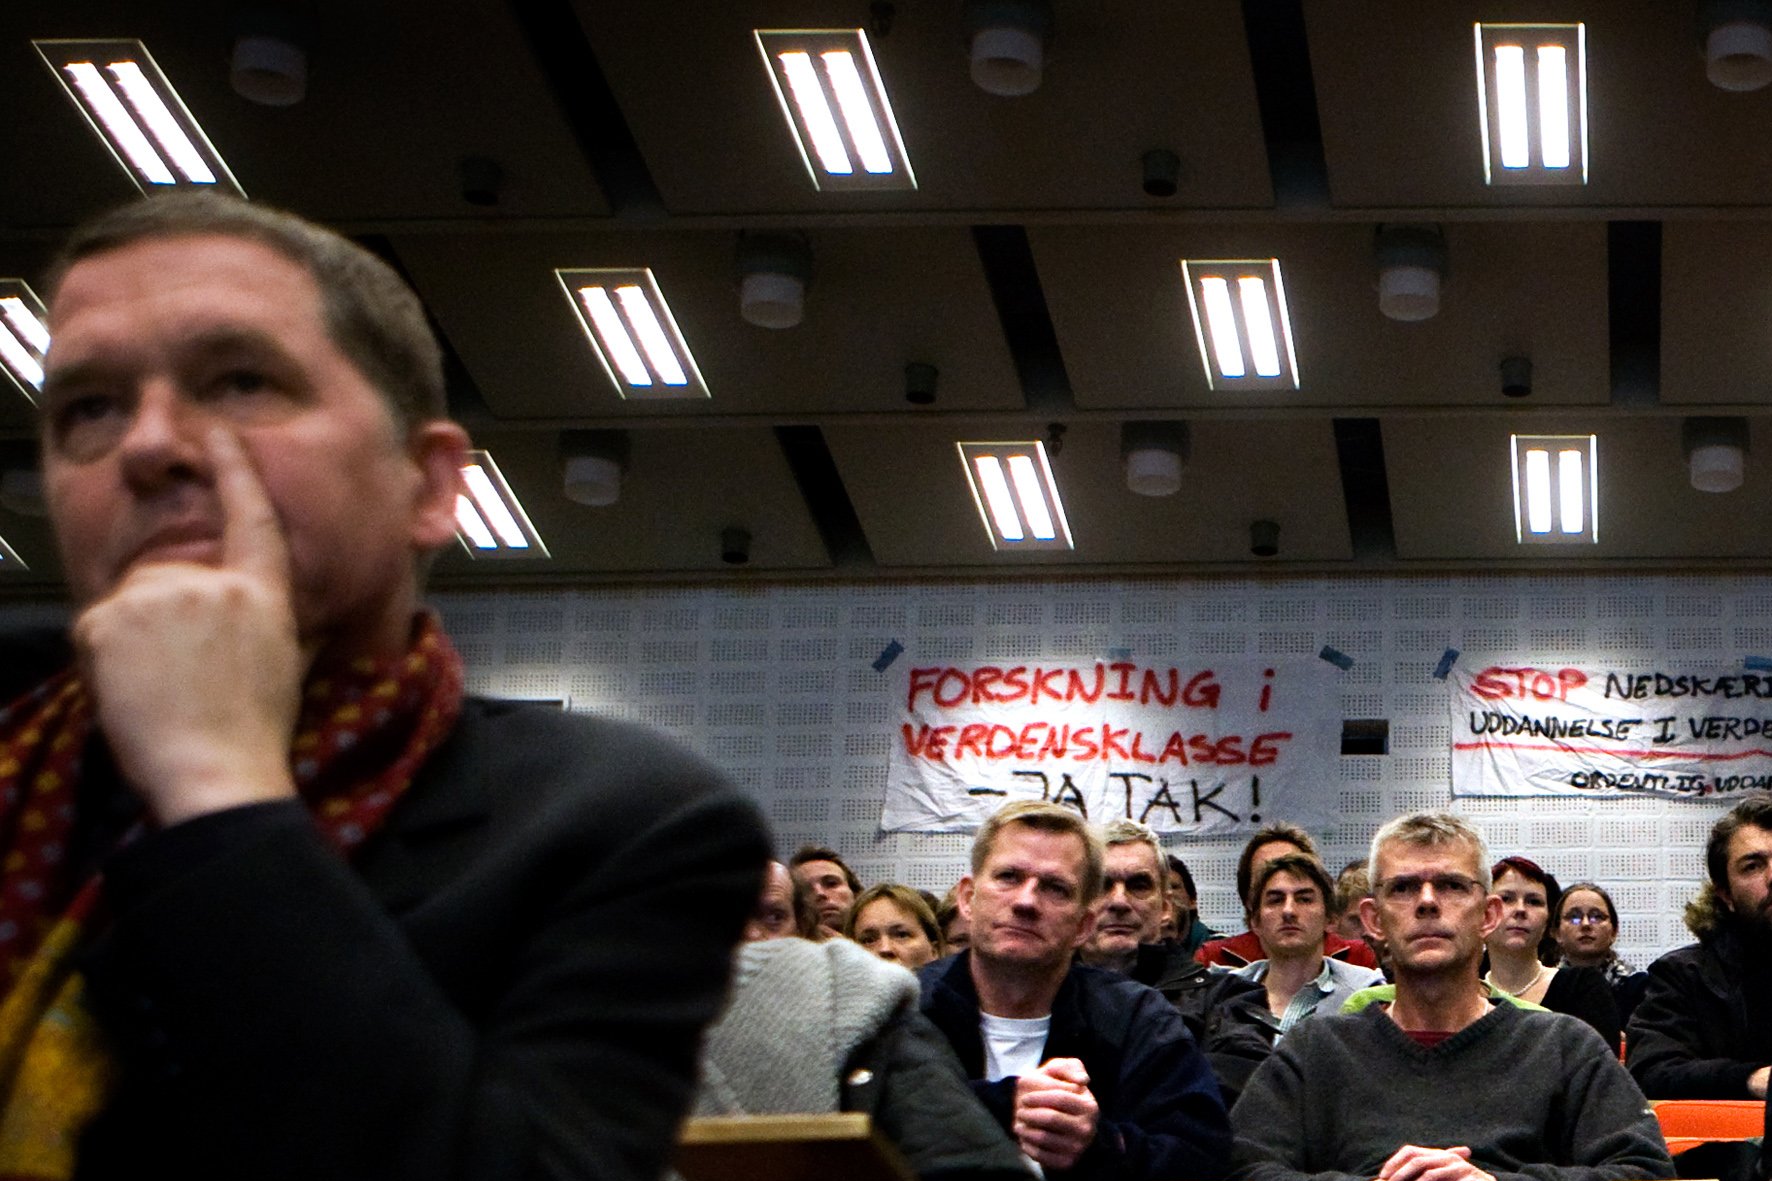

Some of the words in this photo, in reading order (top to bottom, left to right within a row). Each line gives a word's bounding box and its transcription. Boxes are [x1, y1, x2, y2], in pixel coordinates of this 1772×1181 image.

[906, 661, 1221, 714] FORSKNING
[1470, 667, 1588, 701] STOP
[901, 722, 1293, 766] VERDENSKLASSE
[1469, 711, 1642, 741] UDDANNELSE
[1653, 716, 1676, 743] I
[1109, 773, 1262, 824] TAK!
